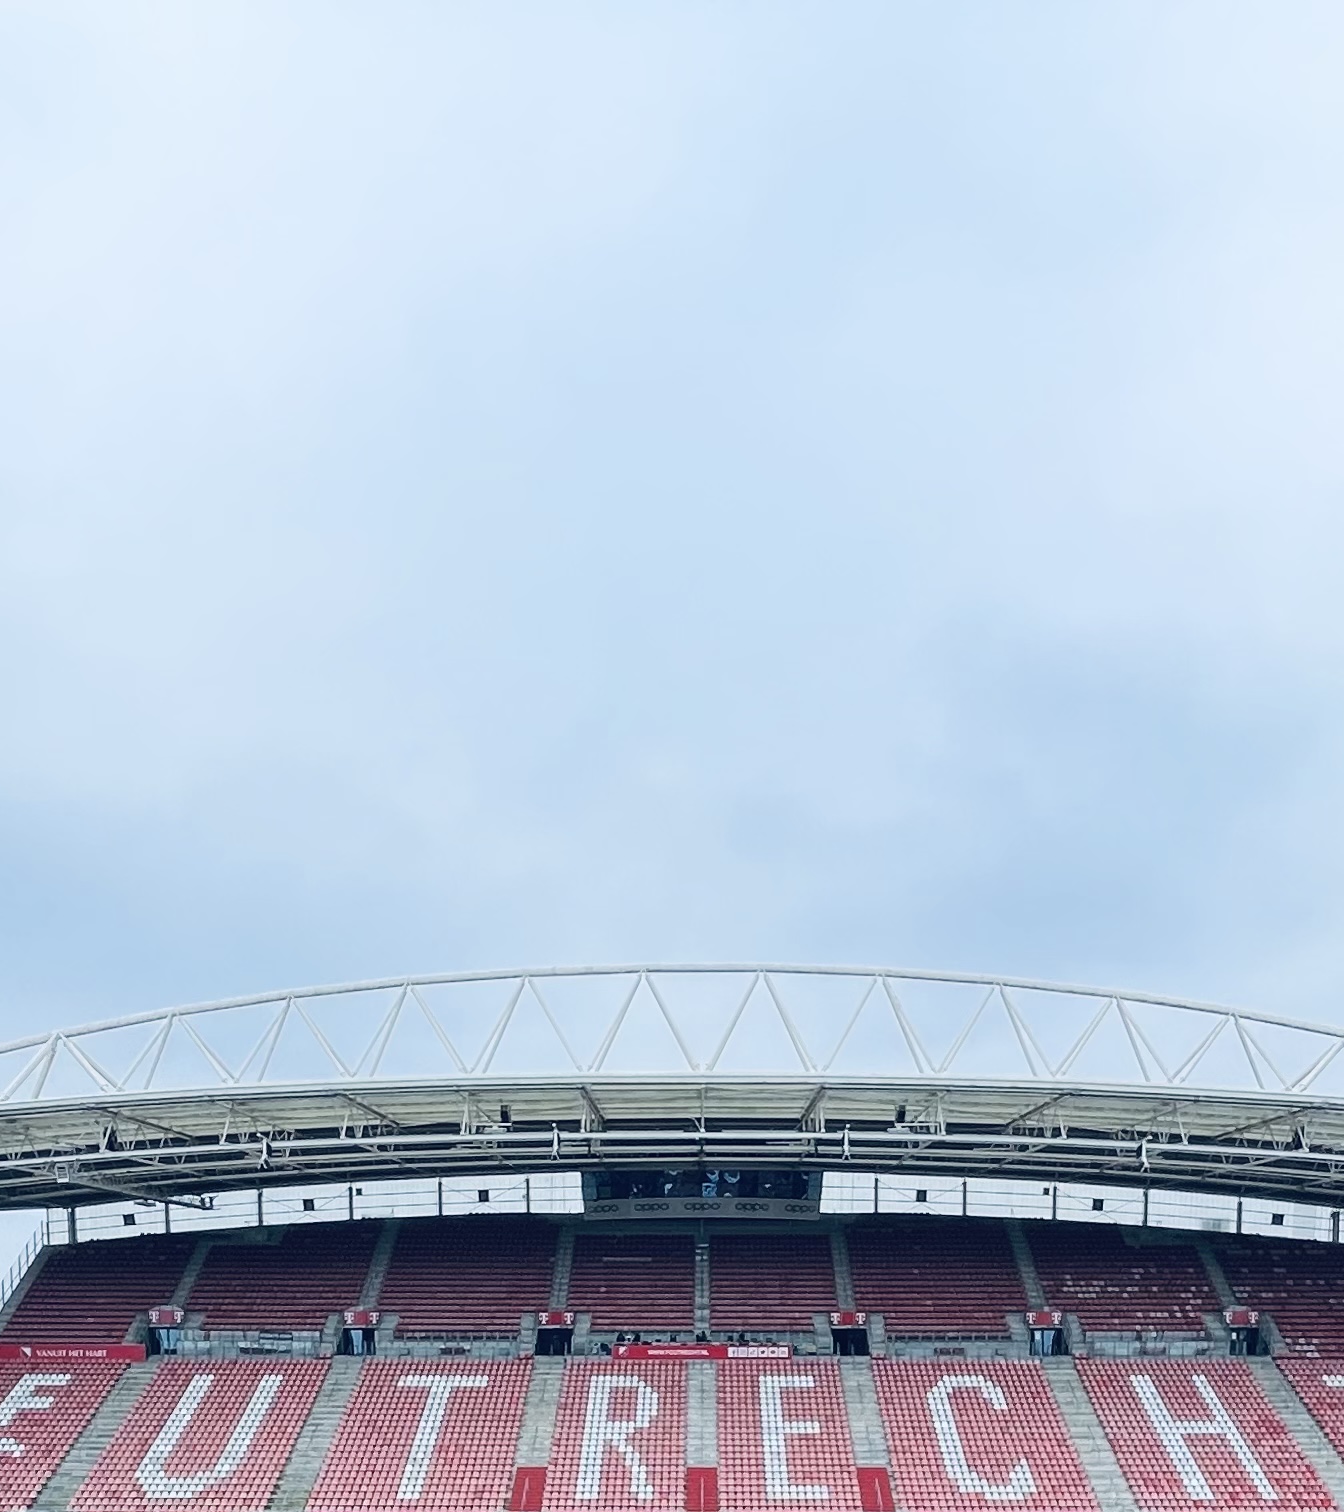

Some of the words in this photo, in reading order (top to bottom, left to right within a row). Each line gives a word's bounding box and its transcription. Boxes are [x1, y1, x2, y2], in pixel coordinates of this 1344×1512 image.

[587, 1204, 618, 1213] oppo
[634, 1202, 669, 1212] oppo
[684, 1202, 720, 1211] oppo
[735, 1202, 769, 1212] oppo
[785, 1204, 816, 1213] oppo
